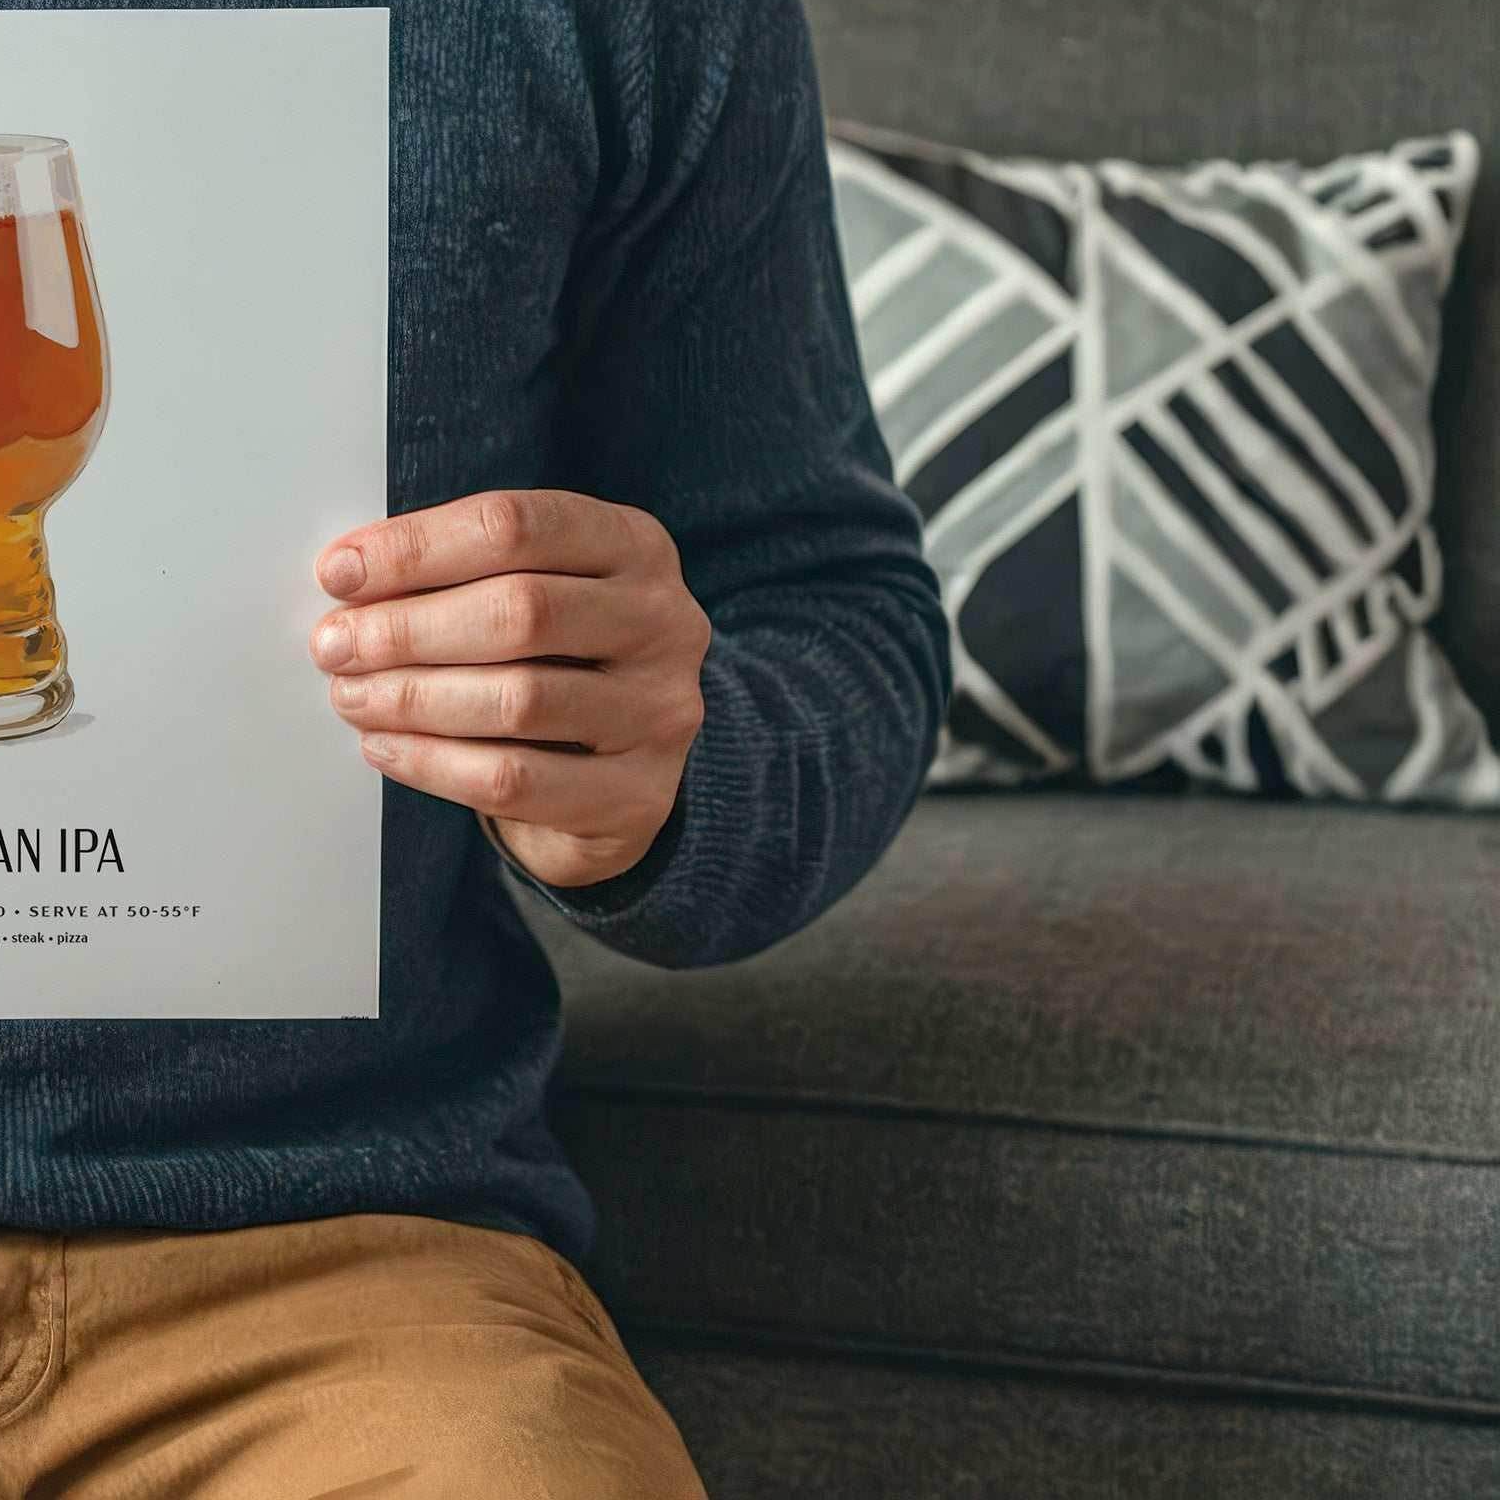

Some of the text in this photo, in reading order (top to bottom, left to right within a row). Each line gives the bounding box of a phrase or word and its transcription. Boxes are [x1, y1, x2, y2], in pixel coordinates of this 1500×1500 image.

[59, 827, 126, 874] IPA
[29, 905, 89, 918] SERVE
[97, 905, 119, 918] AT
[126, 905, 202, 918] 50-55°F
[11, 931, 46, 944] steak
[56, 931, 89, 946] pizza
